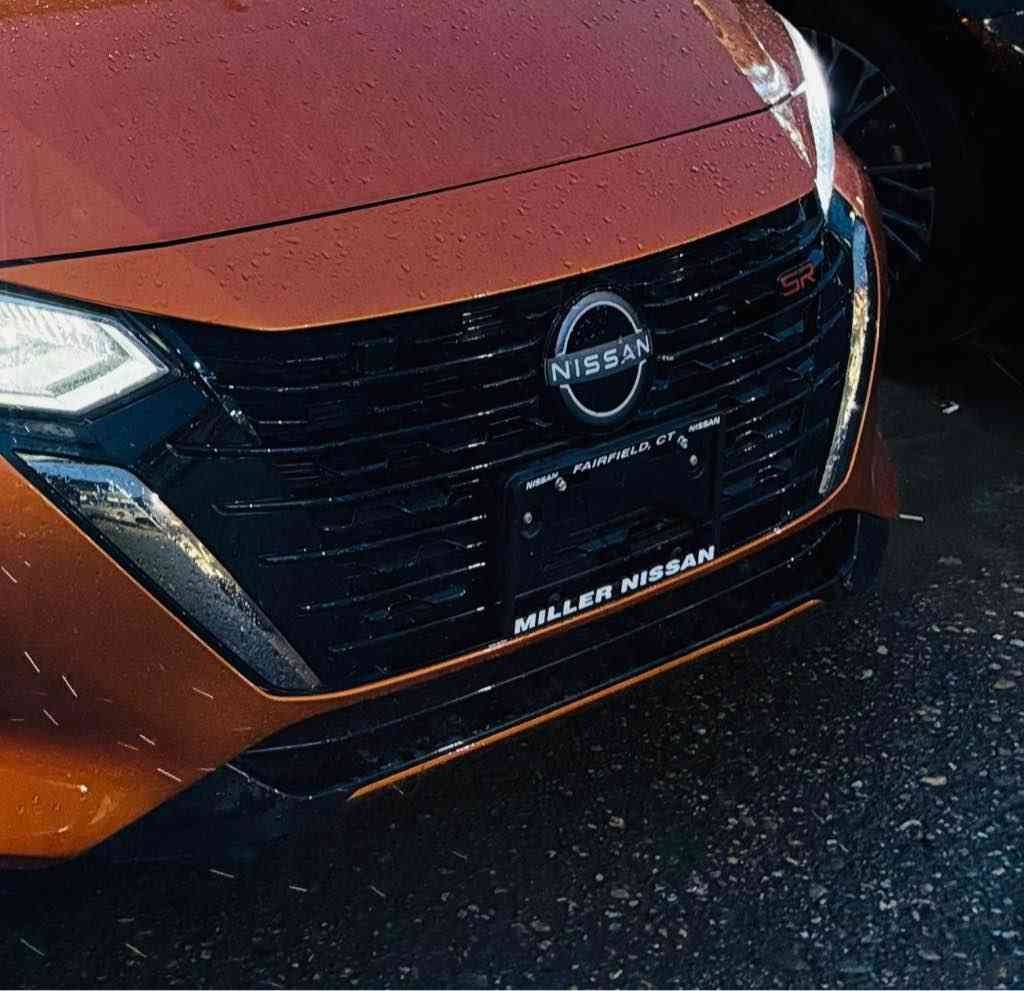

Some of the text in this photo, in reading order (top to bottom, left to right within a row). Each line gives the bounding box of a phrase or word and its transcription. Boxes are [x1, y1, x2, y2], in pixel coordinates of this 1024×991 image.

[780, 263, 816, 296] SR
[551, 334, 650, 382] NISSAN
[526, 416, 720, 491] NISSAN FAIRFIELD, CT NISSAN
[514, 545, 716, 636] MILLER NISSAN
